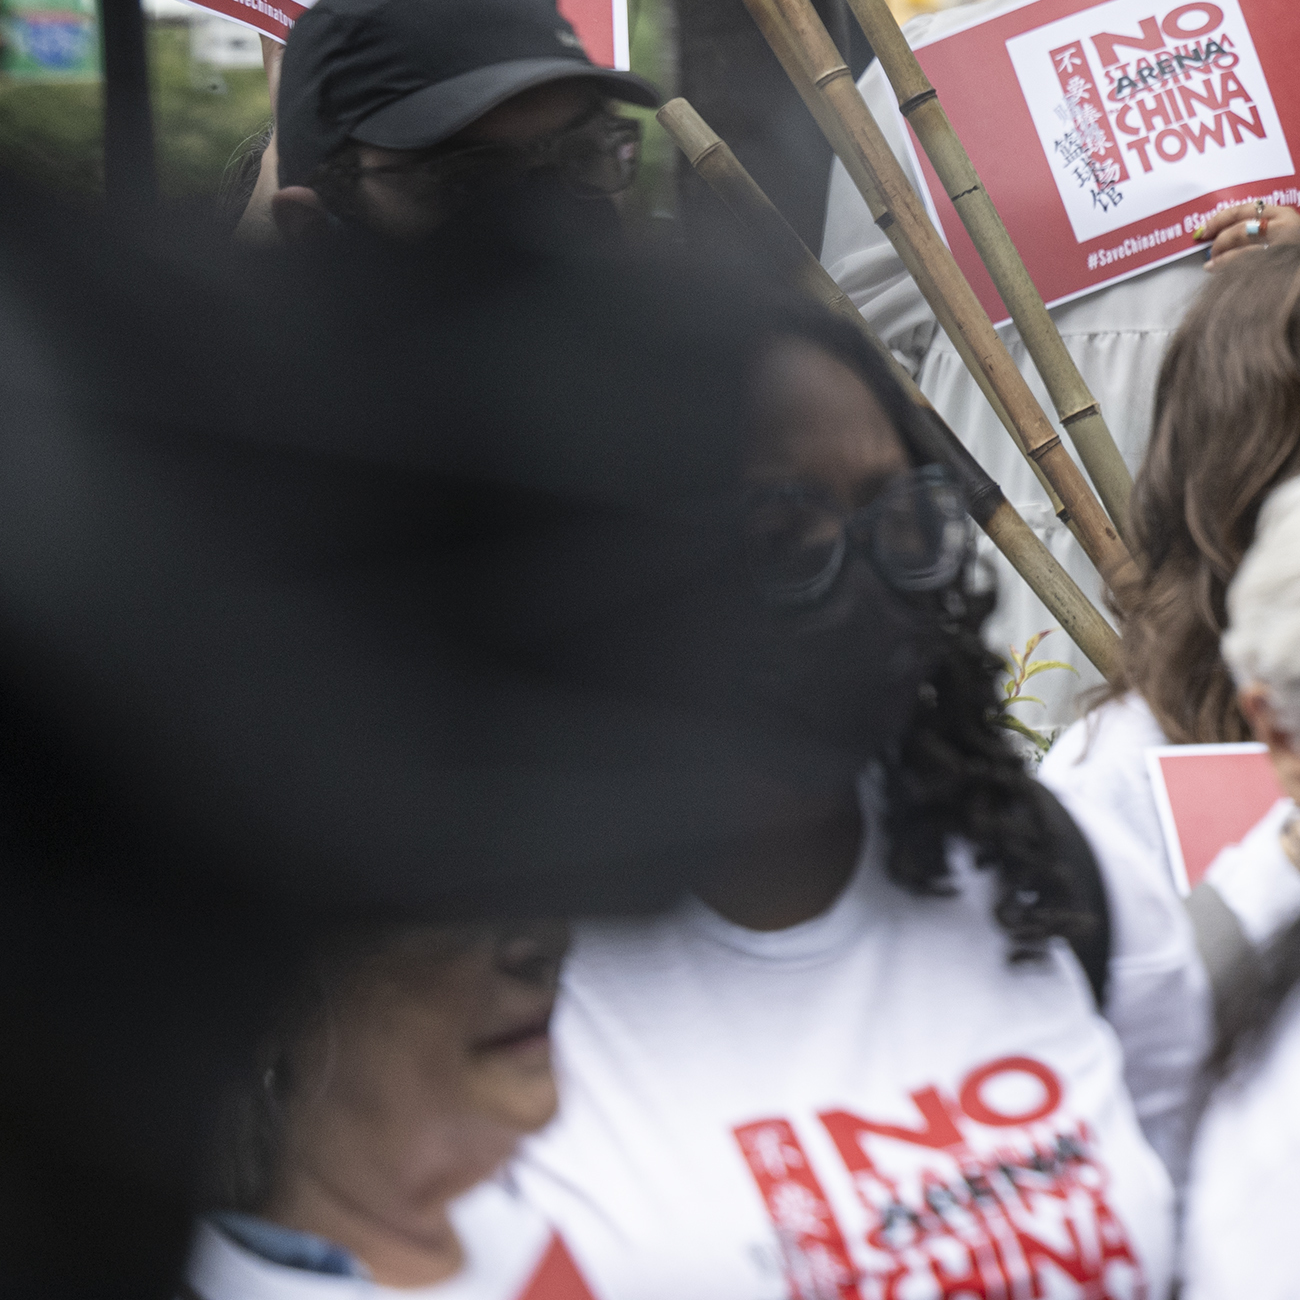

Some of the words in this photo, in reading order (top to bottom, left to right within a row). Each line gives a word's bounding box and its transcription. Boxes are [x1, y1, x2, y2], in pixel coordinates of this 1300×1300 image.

[1089, 2, 1224, 69] NO
[1116, 41, 1227, 94] ARENA
[1116, 70, 1252, 136] CHINA
[1127, 105, 1267, 174] TOWN
[1087, 223, 1183, 270] #SaveChinatown
[818, 1056, 1062, 1171] NO
